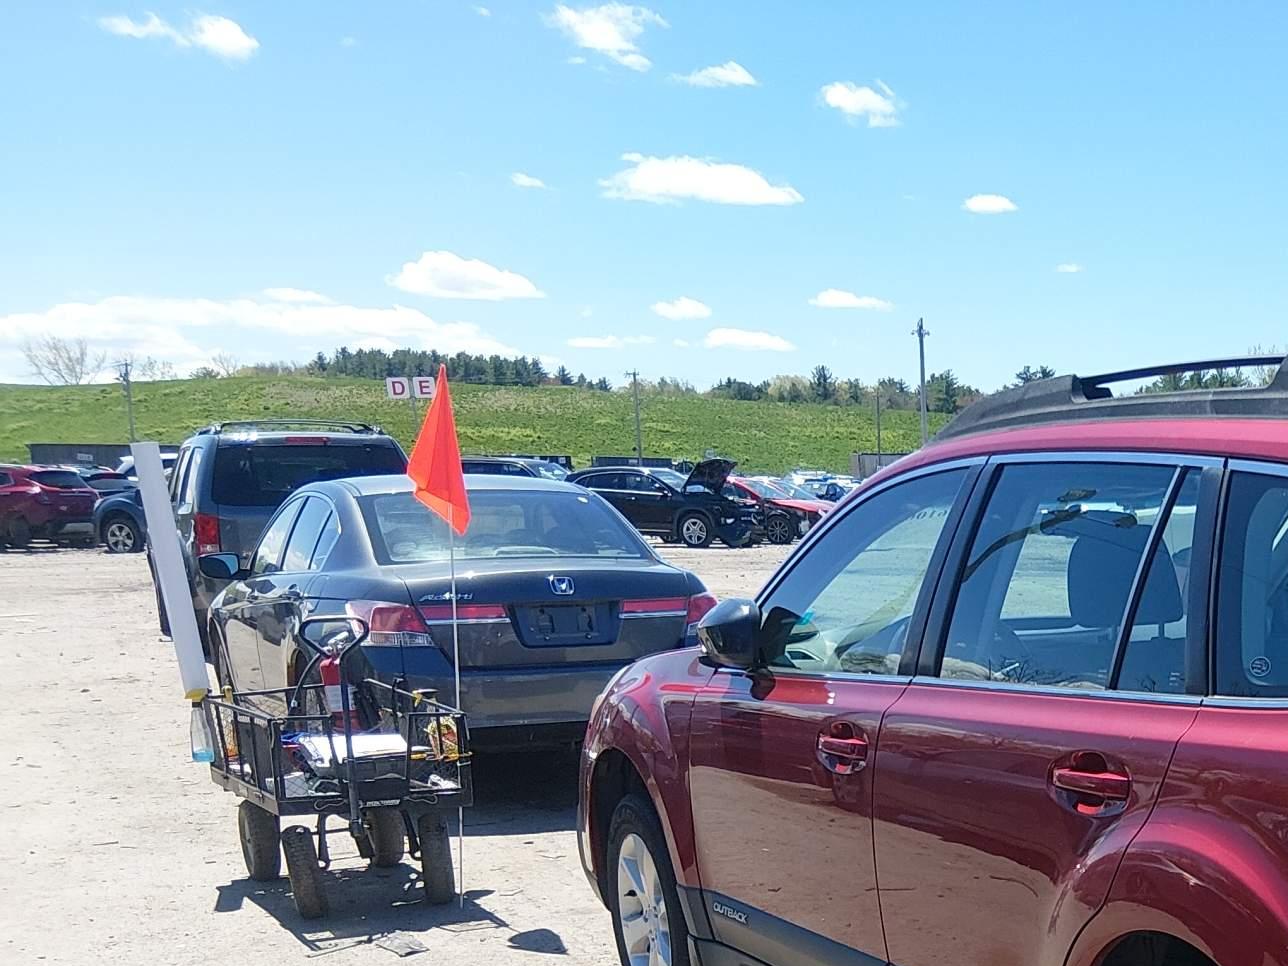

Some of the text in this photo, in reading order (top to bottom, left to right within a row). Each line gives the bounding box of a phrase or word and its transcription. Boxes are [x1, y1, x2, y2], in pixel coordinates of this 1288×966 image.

[392, 380, 431, 396] D E
[713, 902, 747, 924] OUTBACK
